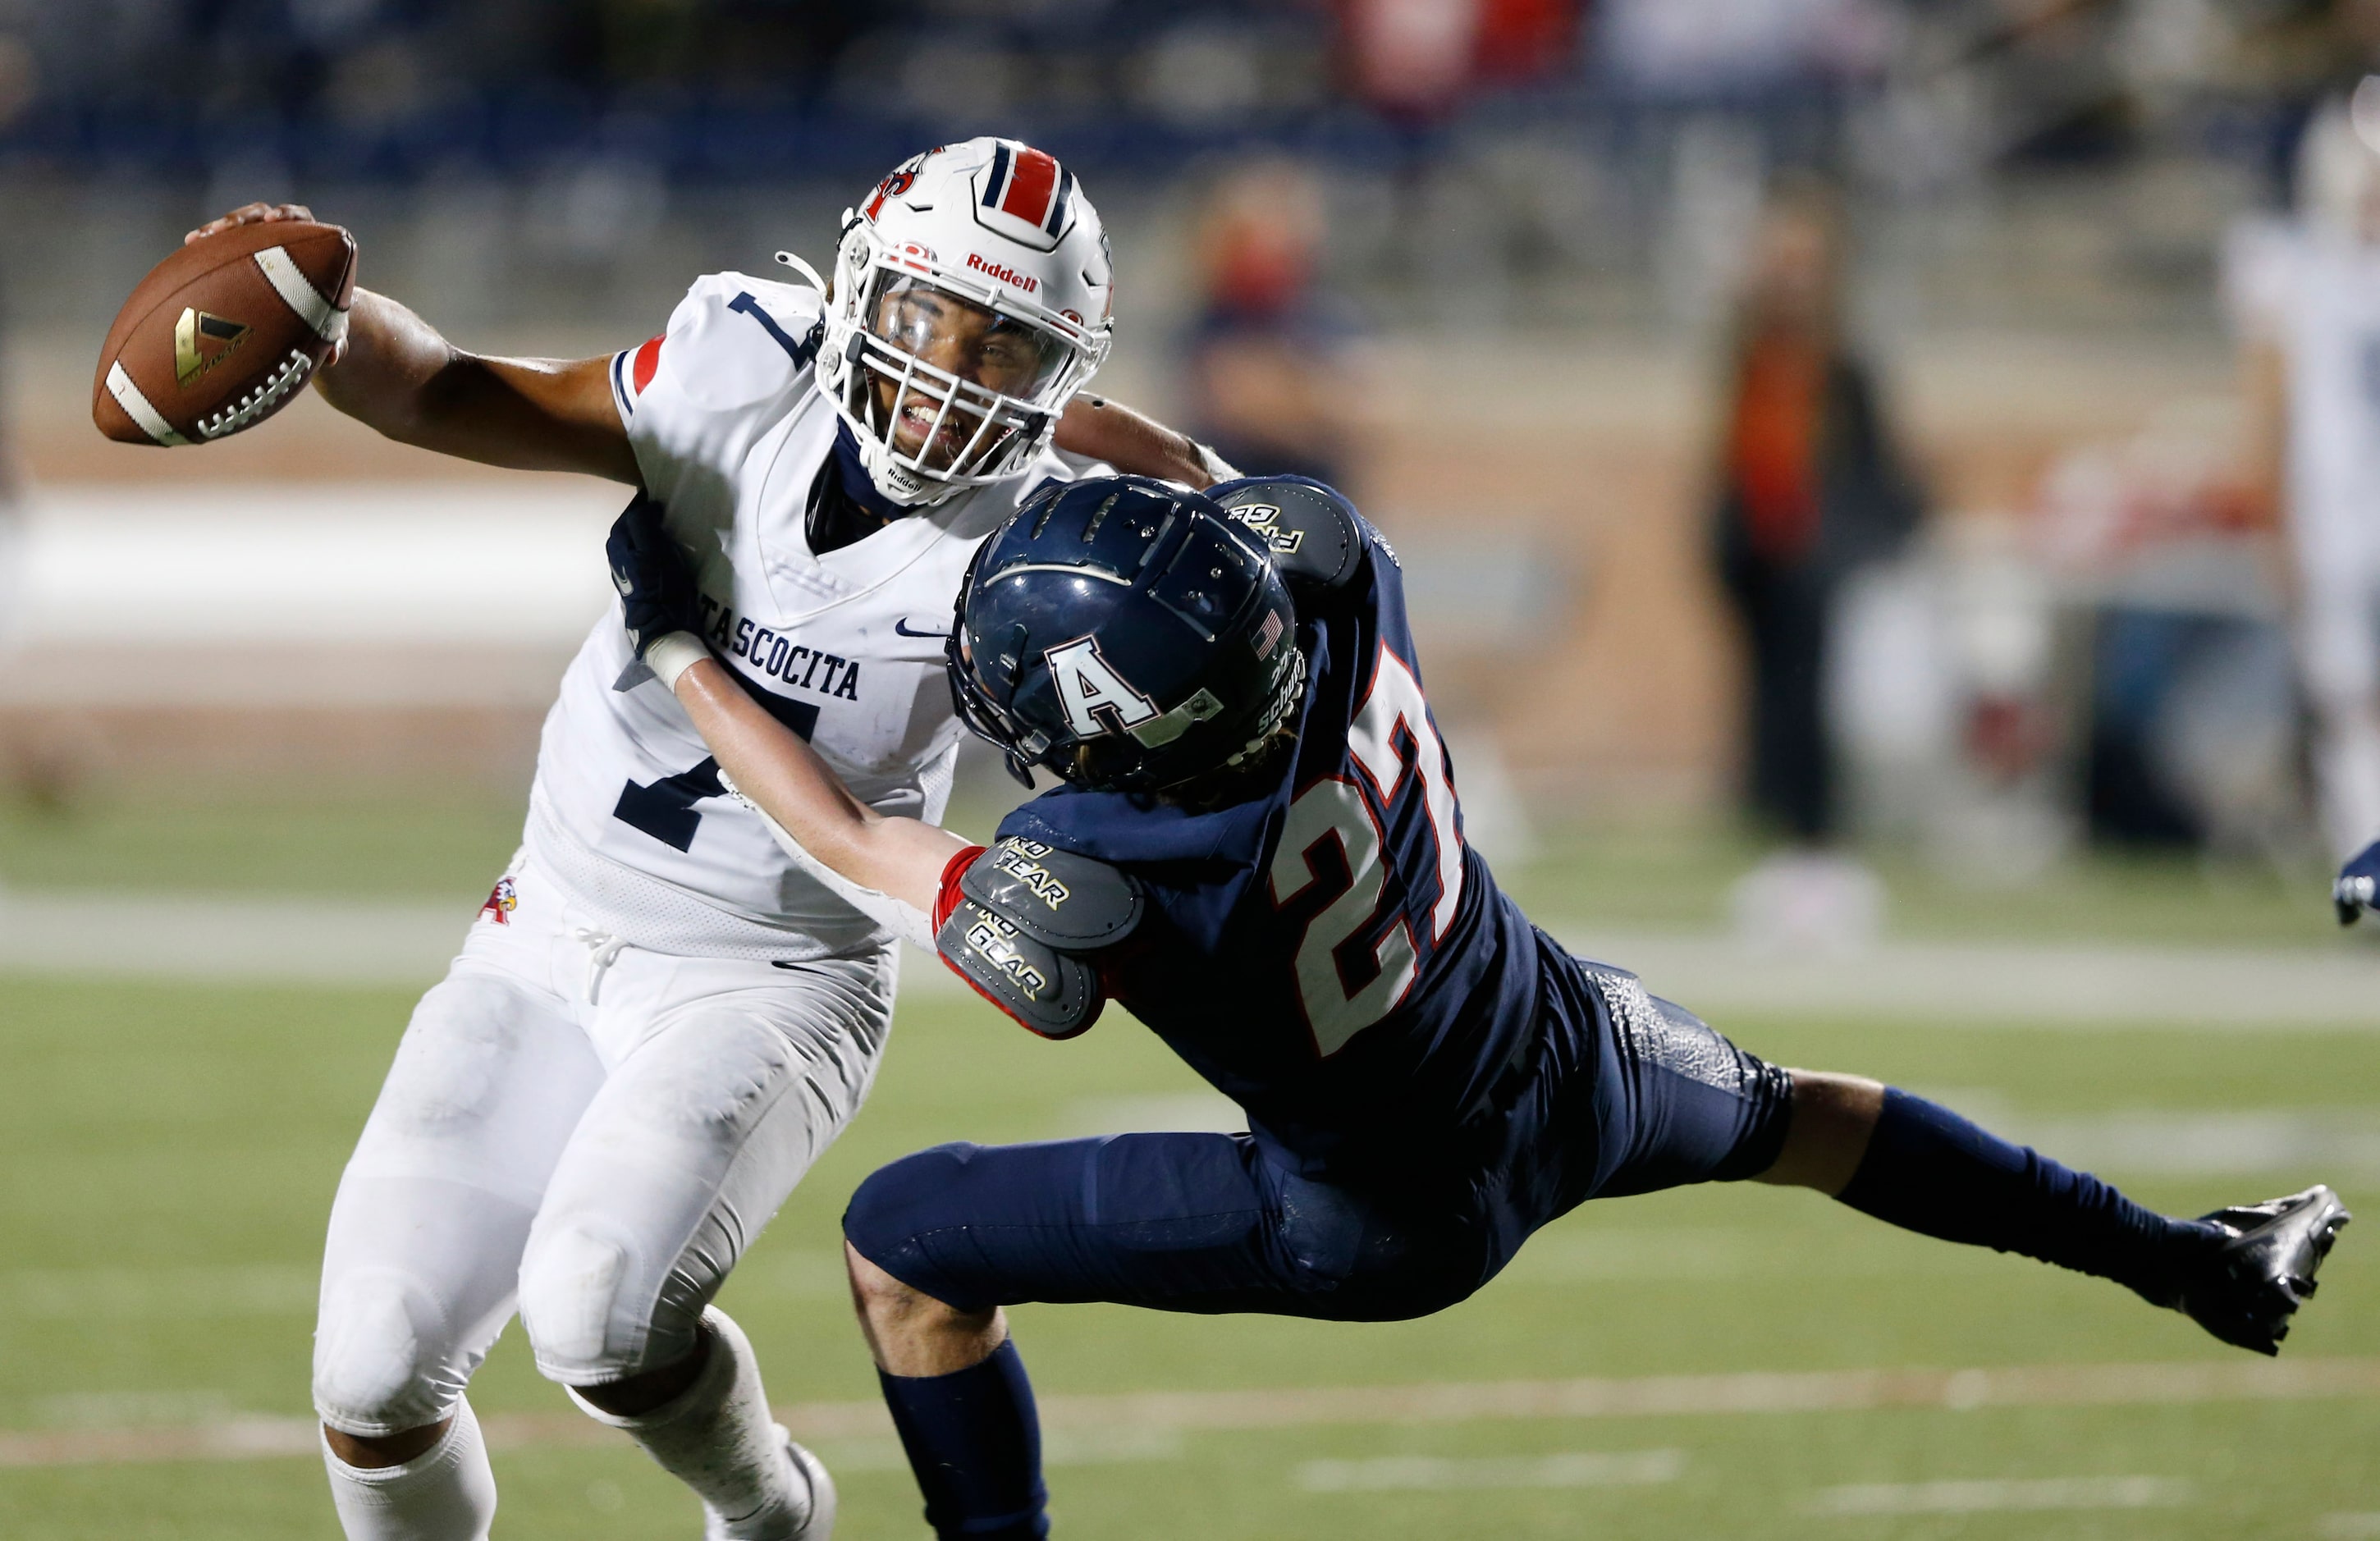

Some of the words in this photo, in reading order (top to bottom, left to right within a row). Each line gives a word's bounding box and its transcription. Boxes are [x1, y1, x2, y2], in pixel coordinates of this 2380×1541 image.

[967, 253, 1037, 293] Riddell
[888, 468, 922, 492] Riddell
[1043, 632, 1162, 740] A
[613, 642, 821, 853] 7
[999, 835, 1054, 859] RO
[1268, 634, 1464, 1062] 27
